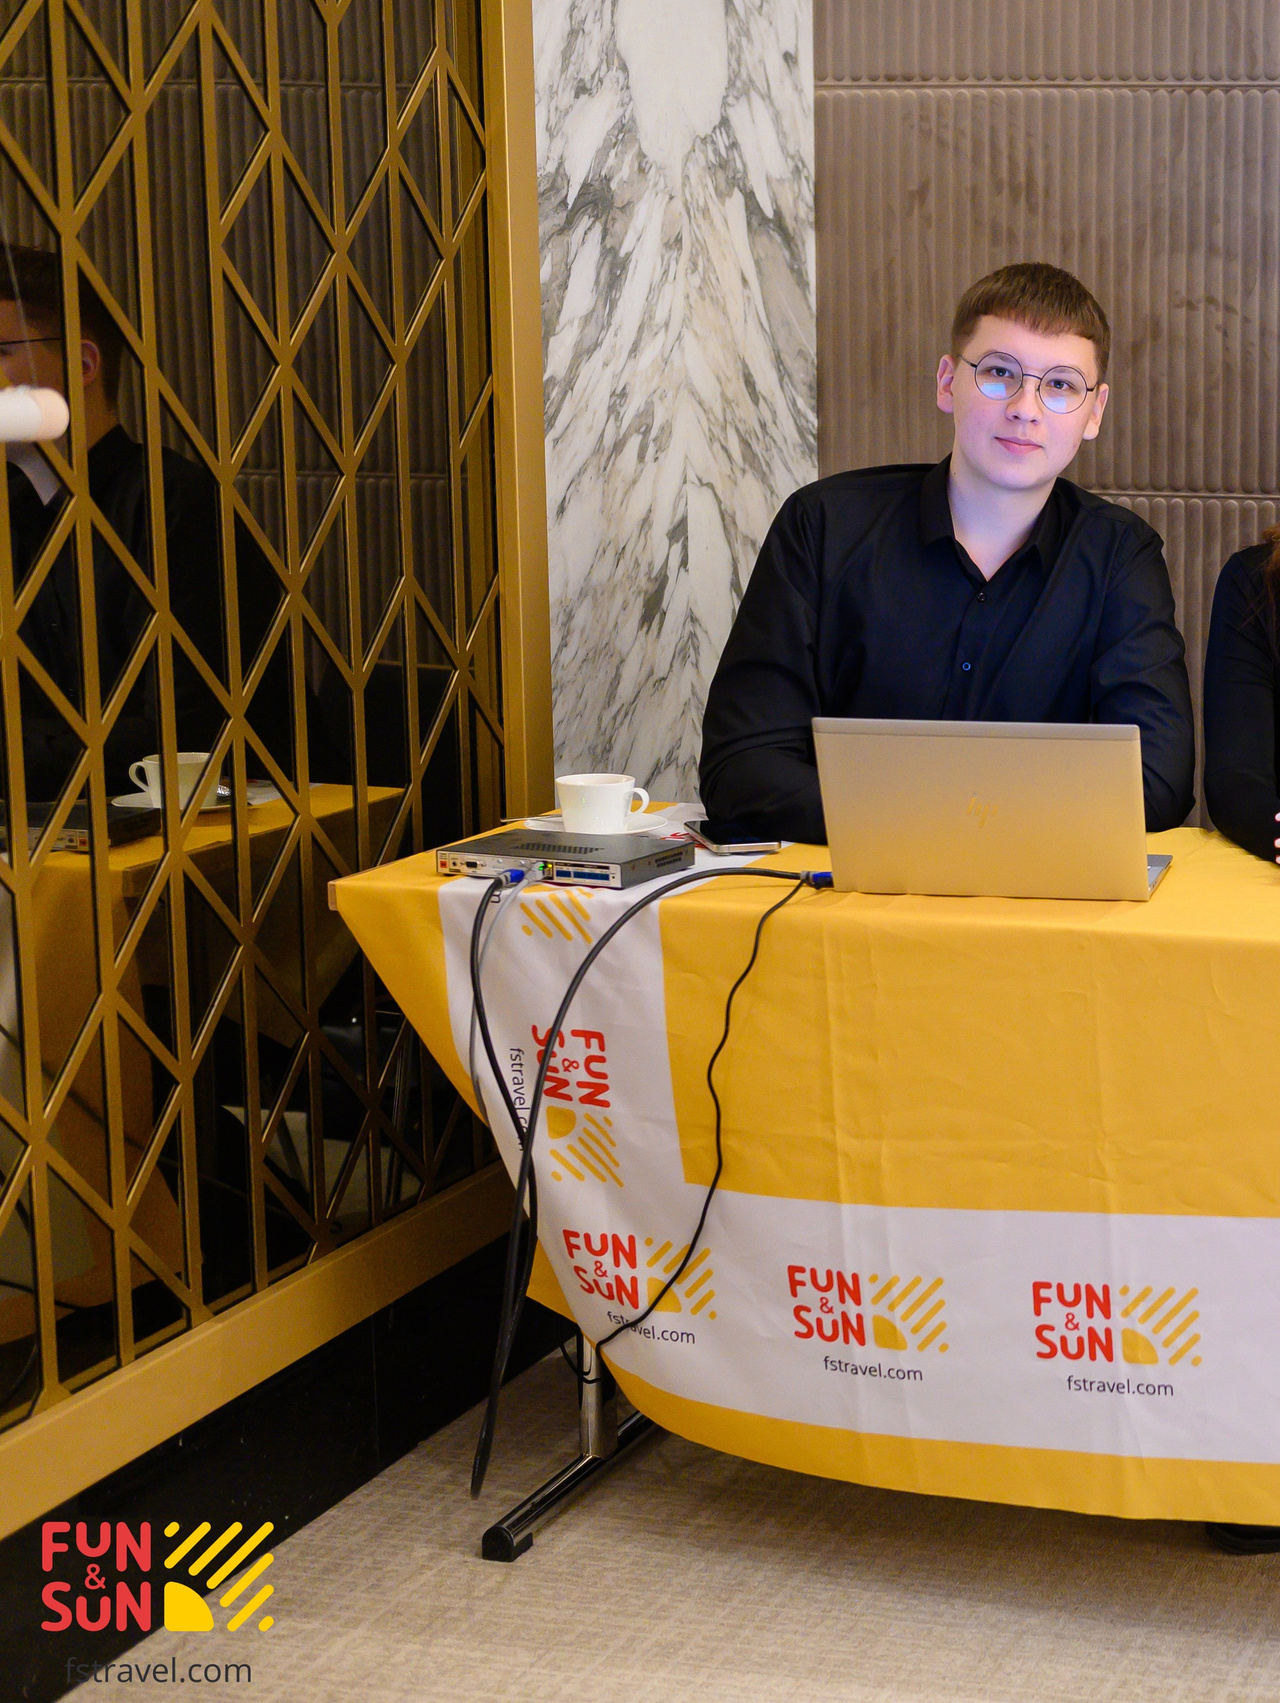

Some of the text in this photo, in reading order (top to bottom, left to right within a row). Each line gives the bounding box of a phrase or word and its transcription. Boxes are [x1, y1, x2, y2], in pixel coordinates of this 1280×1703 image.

[561, 1058, 580, 1073] &
[571, 1029, 611, 1108] FUN
[562, 1229, 637, 1269] FUN
[573, 1265, 639, 1310] SUN
[594, 1260, 608, 1278] &
[787, 1265, 862, 1307] FUN
[819, 1296, 834, 1314] &
[1032, 1281, 1111, 1320] FUN
[793, 1304, 866, 1347] SUN
[1064, 1312, 1080, 1331] &
[1035, 1324, 1114, 1363] SUN
[823, 1356, 923, 1381] fstravel.com
[1067, 1375, 1174, 1396] fstravel.com
